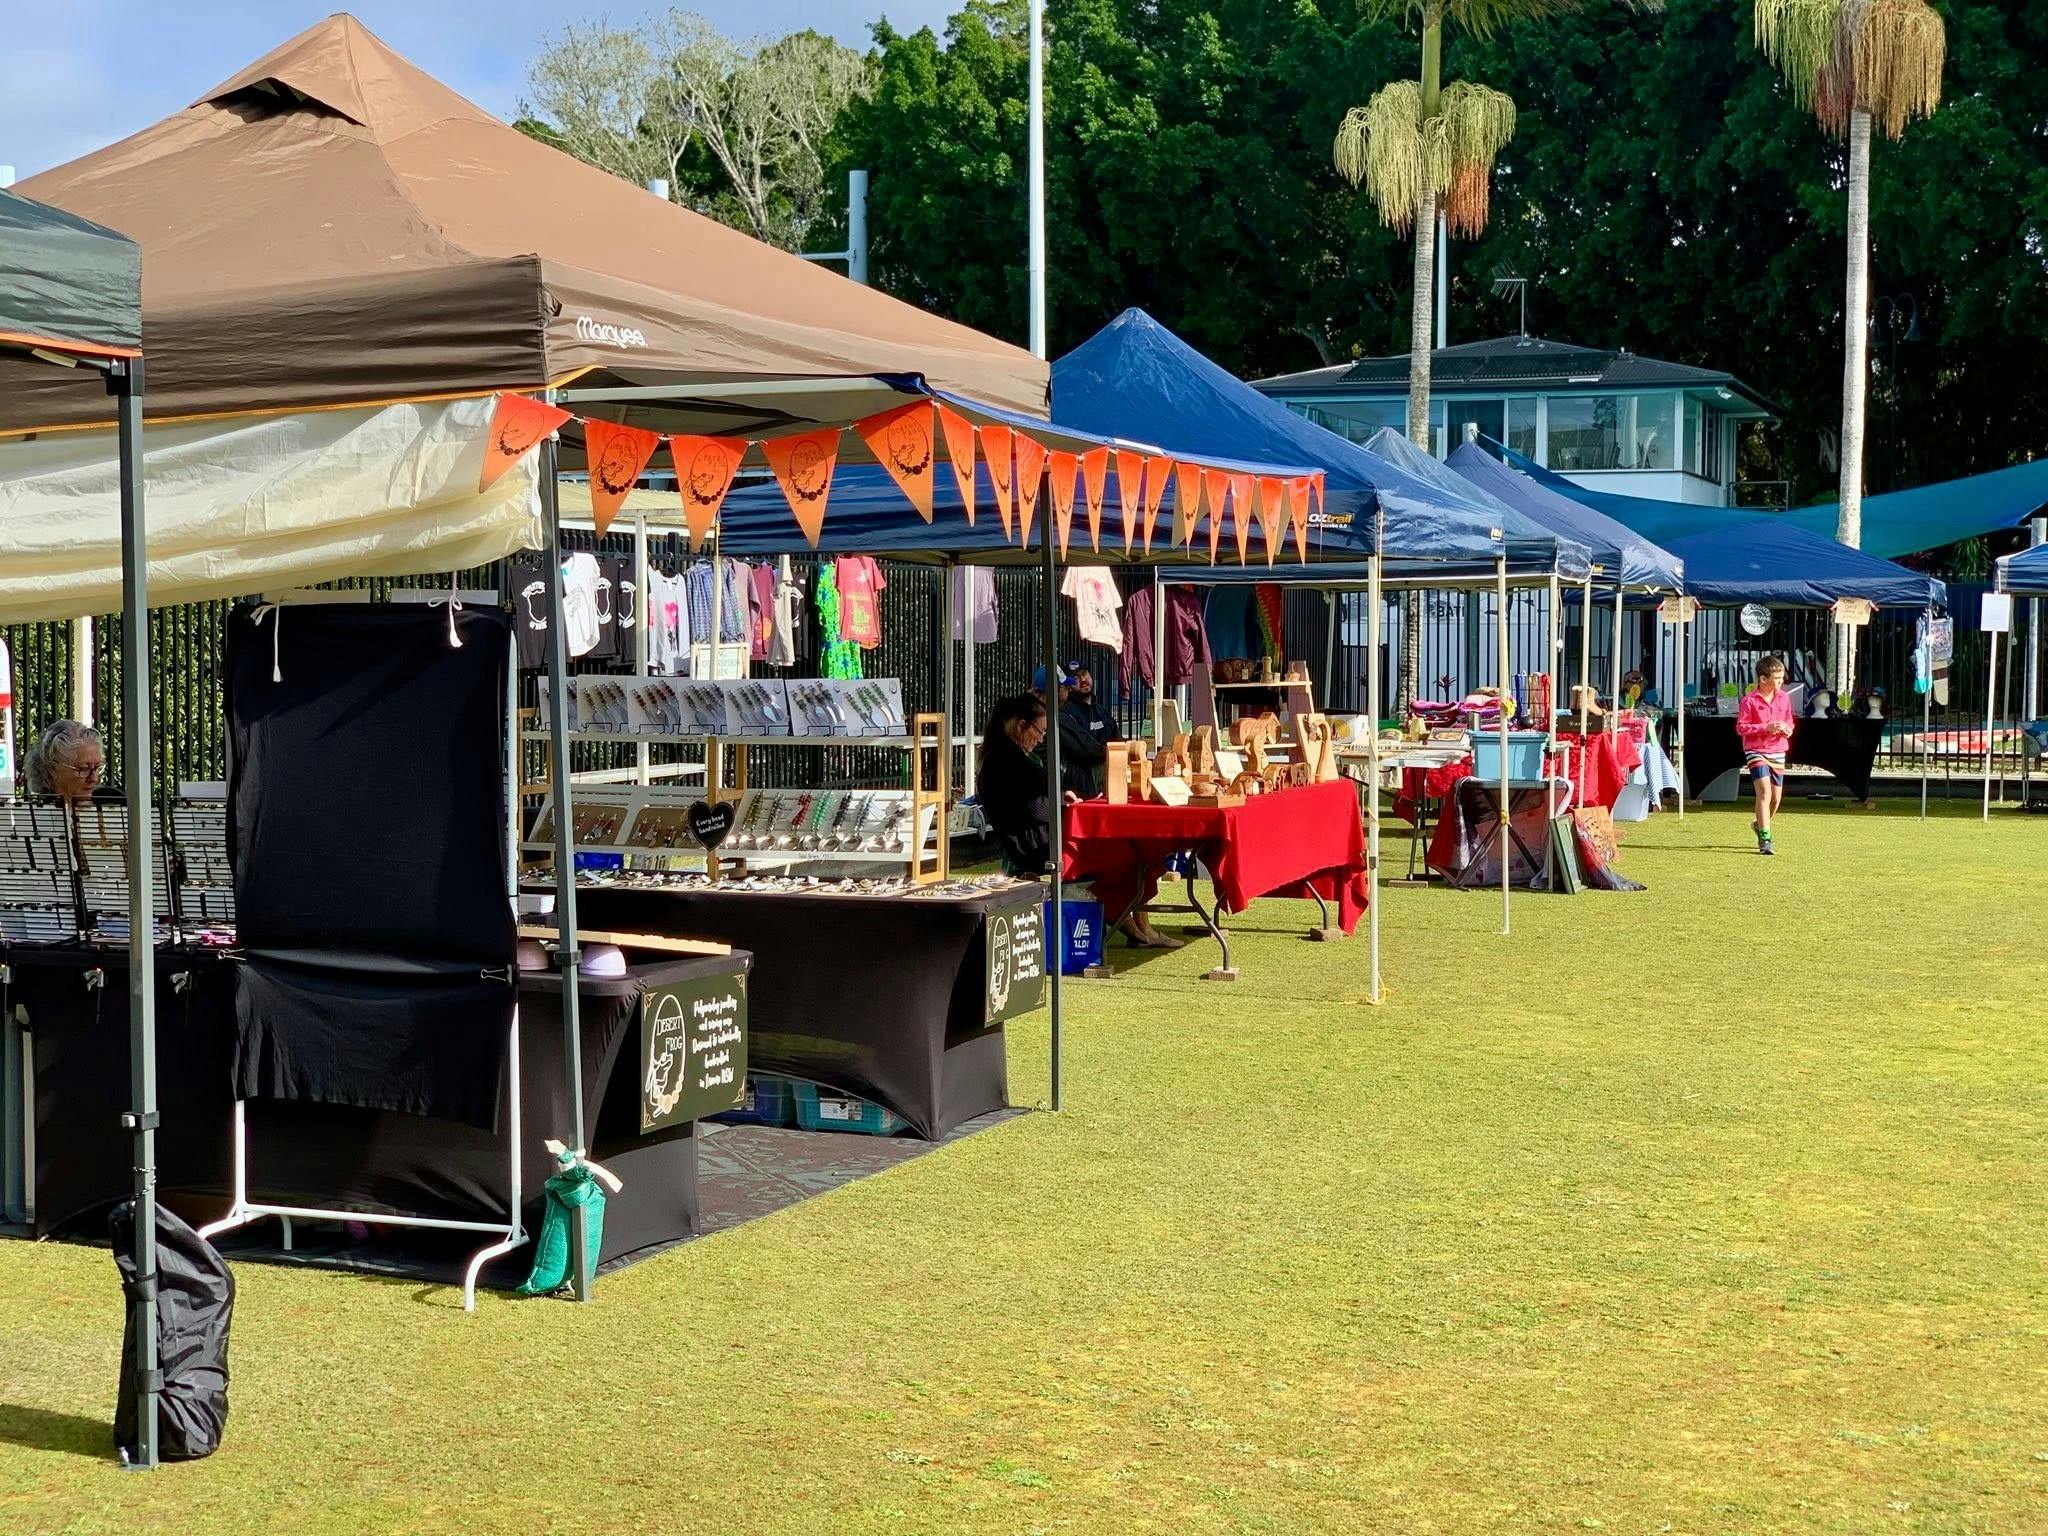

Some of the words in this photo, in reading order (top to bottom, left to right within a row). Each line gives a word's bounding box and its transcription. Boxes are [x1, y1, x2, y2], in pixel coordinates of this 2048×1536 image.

[576, 316, 647, 349] Marquee
[1309, 513, 1353, 524] OZtrail
[656, 1015, 682, 1036] DESERT
[665, 1036, 682, 1052] FROG
